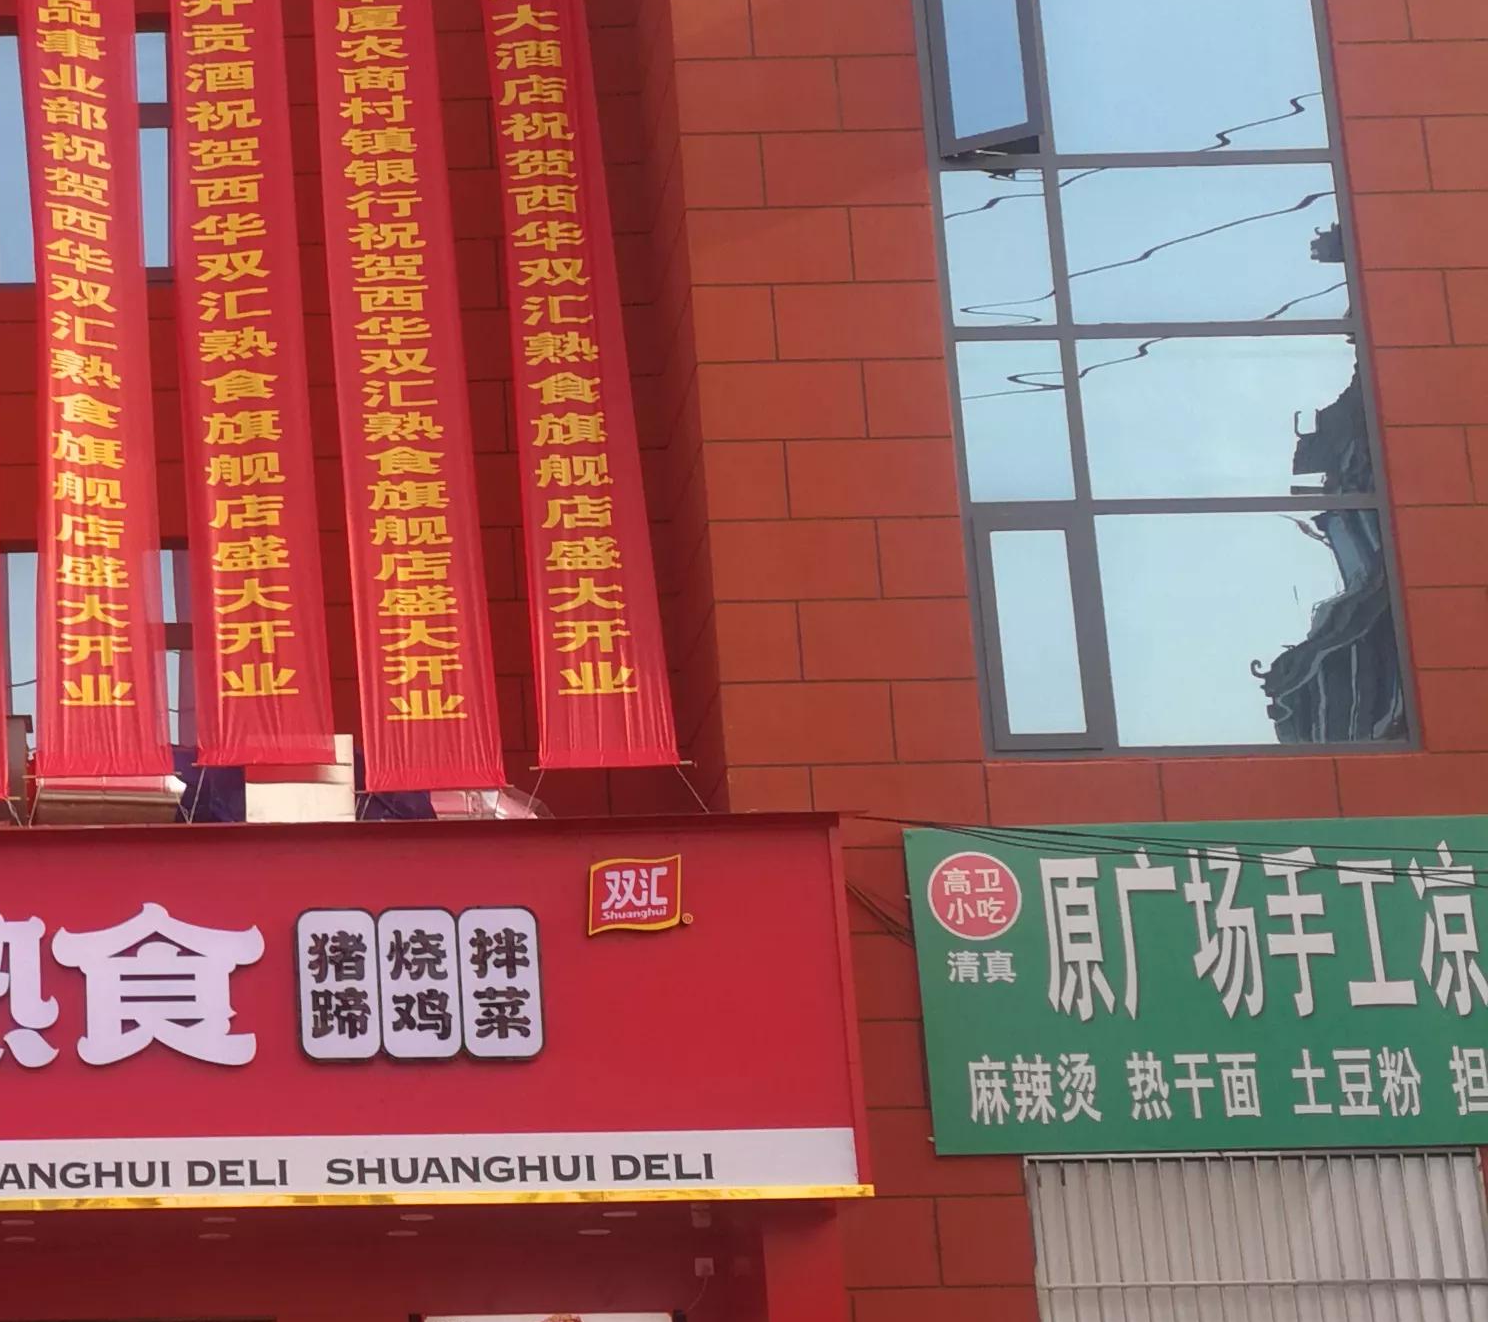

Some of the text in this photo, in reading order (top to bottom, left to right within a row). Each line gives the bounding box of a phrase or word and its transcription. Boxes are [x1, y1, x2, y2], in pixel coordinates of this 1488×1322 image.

[601, 866, 668, 910] 双汇
[942, 866, 1004, 895] 高卫
[600, 906, 667, 920] Shuanghui
[947, 897, 1007, 925] 小吃
[1038, 840, 1488, 1022] 原广场手工凉
[308, 931, 371, 1040] 猪蹄
[387, 929, 453, 1042] 烧鸡
[469, 928, 533, 1039] 拌菜
[947, 950, 1017, 984] 清真
[967, 1051, 1103, 1126] 麻辣烫
[1126, 1051, 1262, 1121] 热干面
[1291, 1046, 1421, 1119] 土豆粉
[187, 1158, 288, 1188] DELI
[326, 1154, 597, 1186] SHUANGHUI
[610, 1152, 715, 1182] DELI
